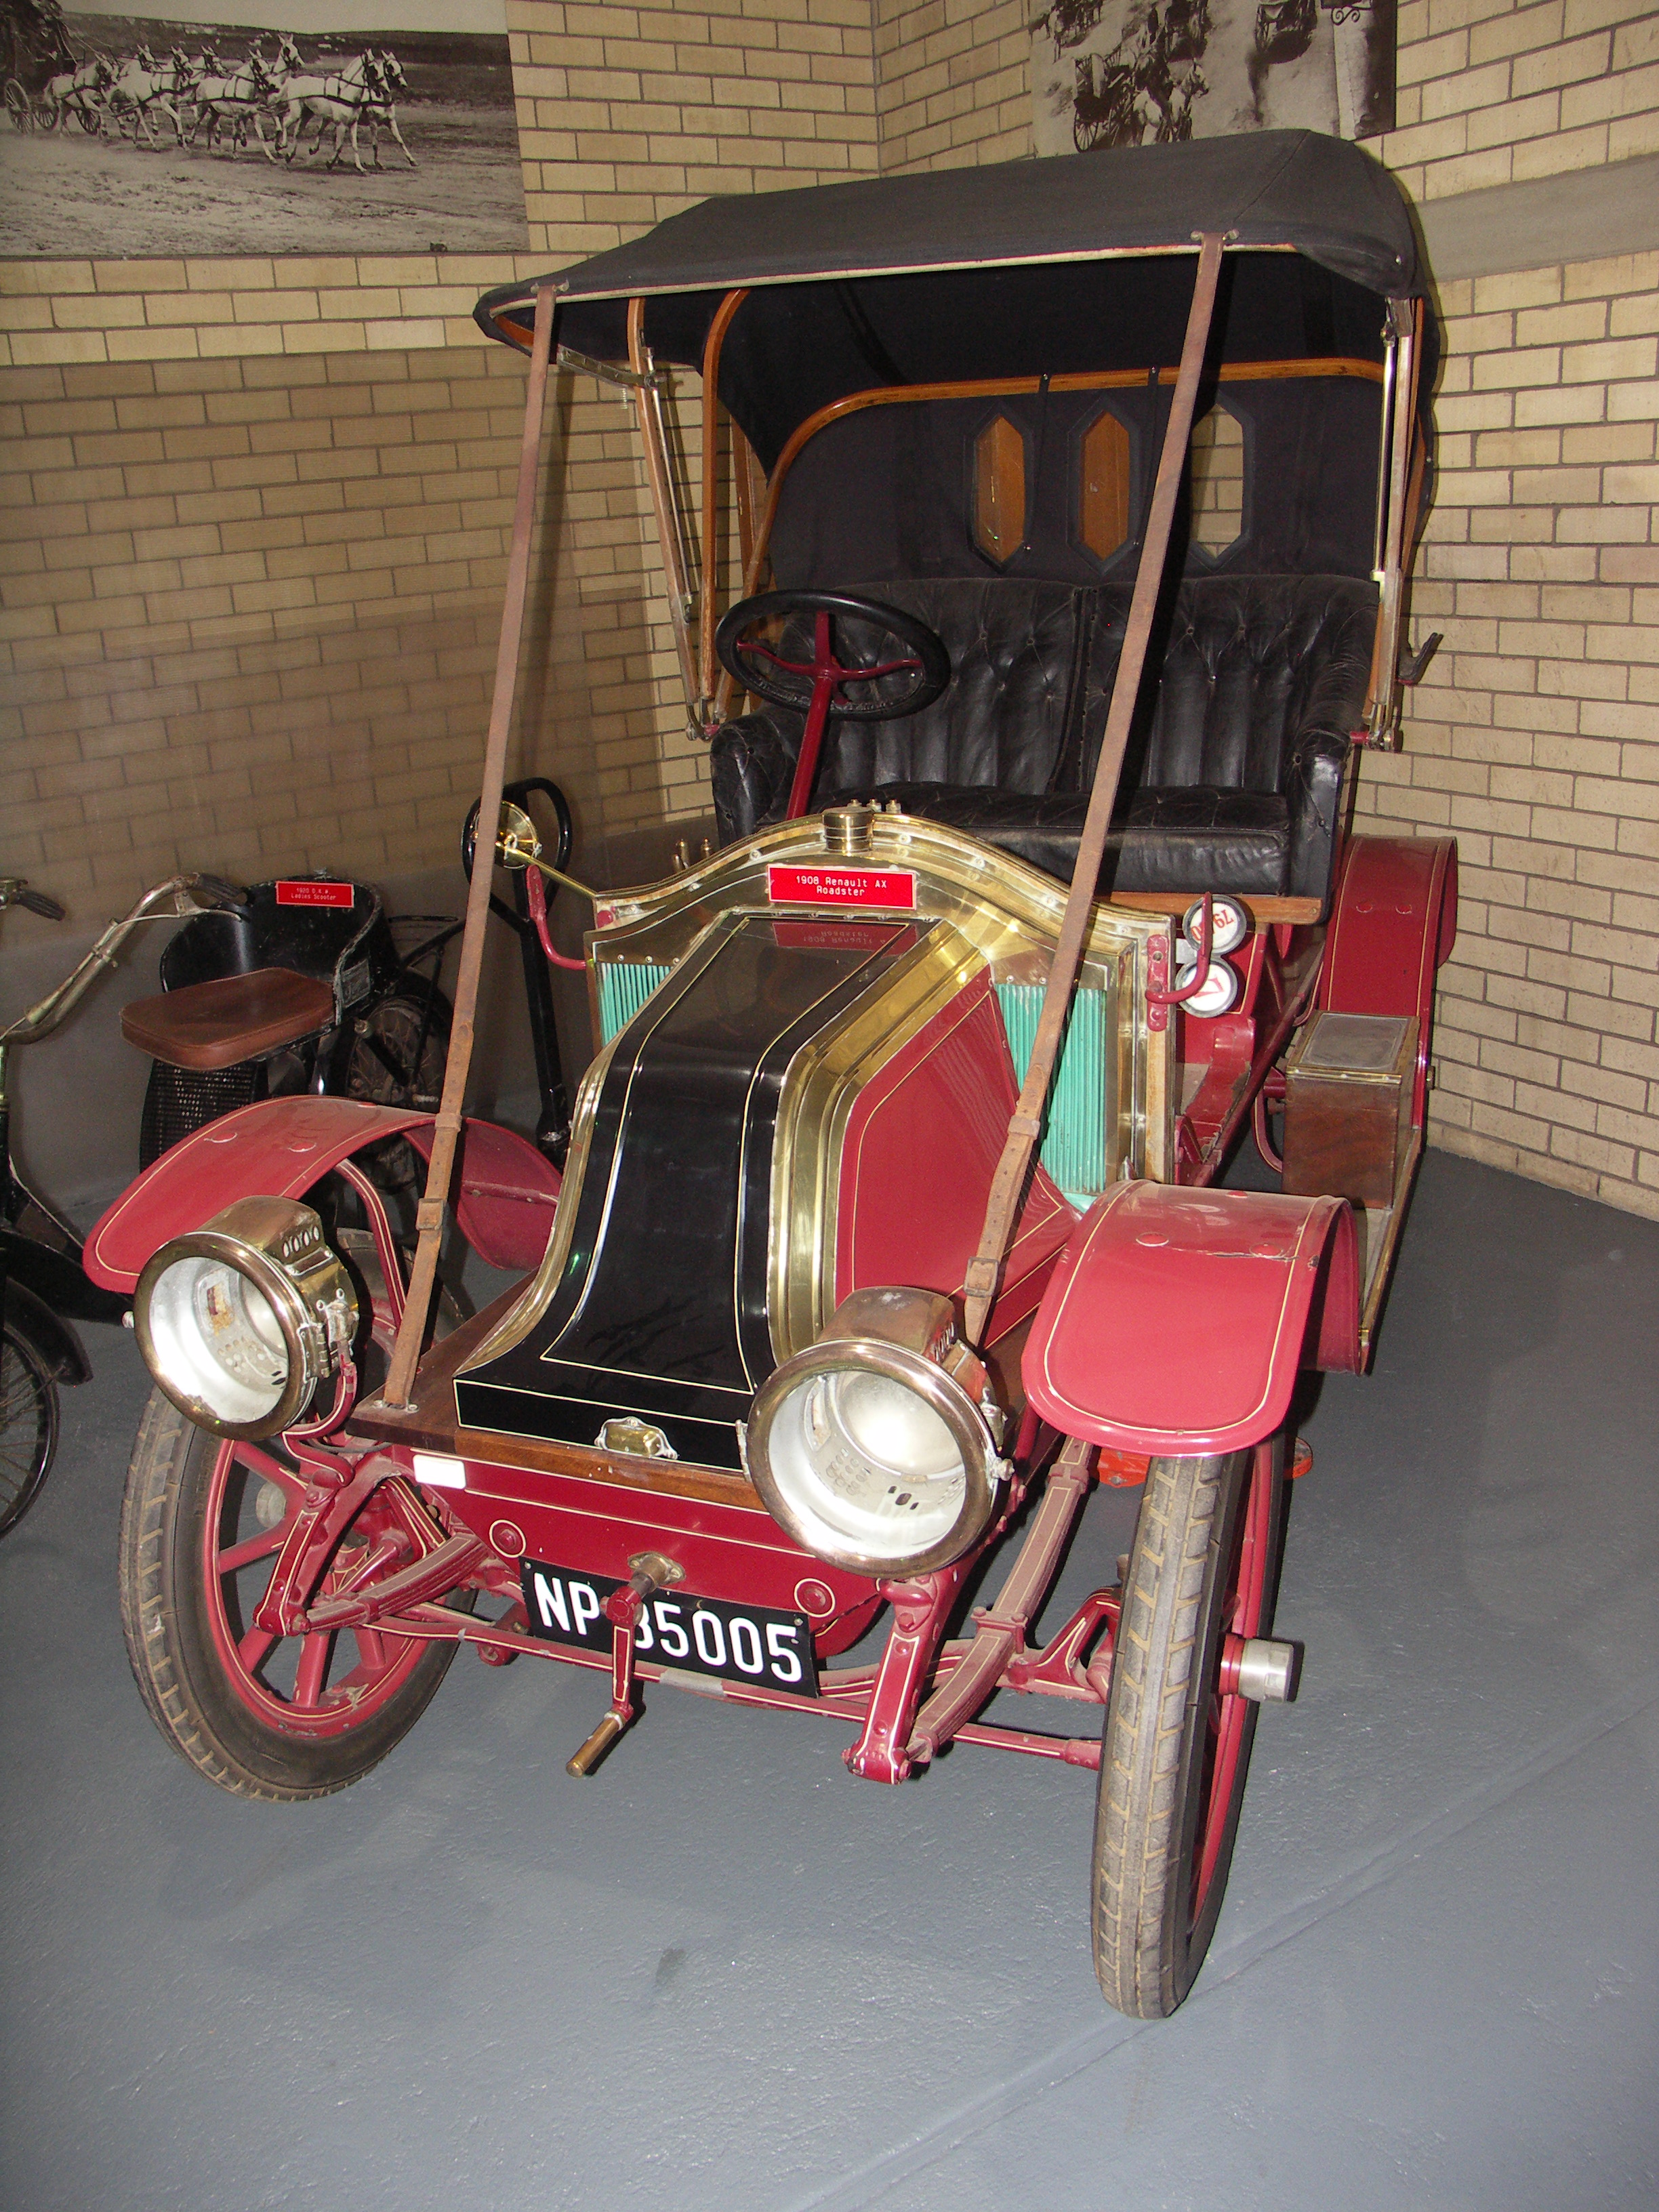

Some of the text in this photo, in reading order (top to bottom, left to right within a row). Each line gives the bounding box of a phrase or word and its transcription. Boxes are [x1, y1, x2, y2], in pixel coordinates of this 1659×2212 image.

[796, 875, 887, 888] 1908 Renault AX
[816, 885, 865, 896] Roadster
[533, 1572, 600, 1636] NP
